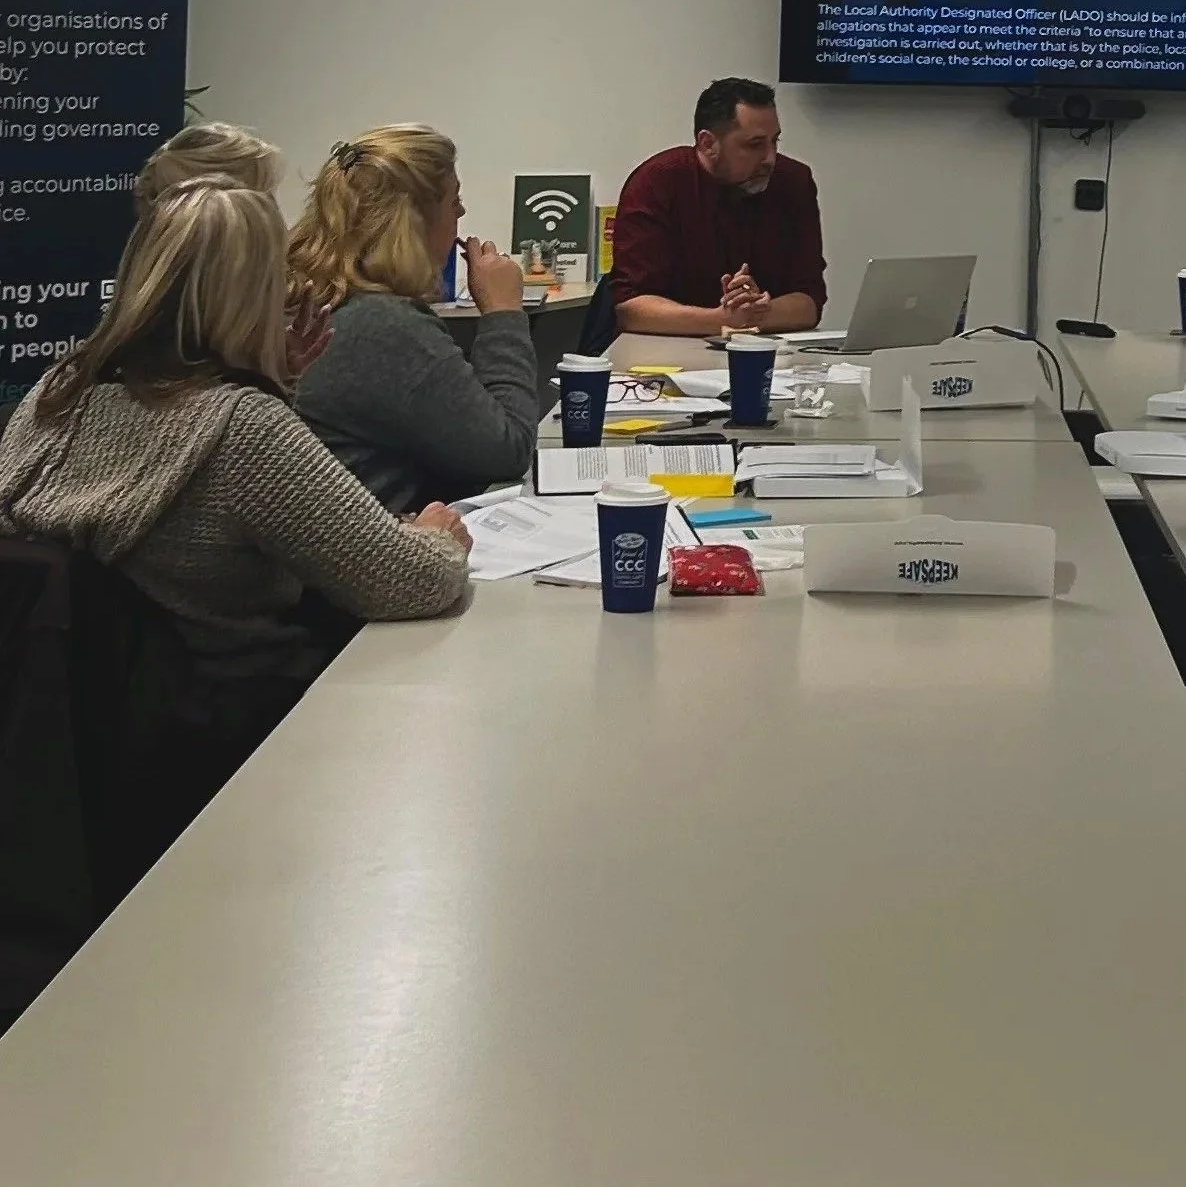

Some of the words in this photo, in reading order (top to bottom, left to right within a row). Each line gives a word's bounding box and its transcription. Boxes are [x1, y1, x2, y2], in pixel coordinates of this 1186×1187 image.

[7, 11, 144, 31] organisations
[148, 13, 168, 30] of
[817, 3, 842, 15] The
[844, 4, 877, 16] Local
[878, 5, 939, 19] Authority
[940, 6, 1013, 20] Designated
[1014, 8, 1057, 20] Officer
[1059, 9, 1104, 23] (LADO)
[1106, 10, 1149, 23] should
[1151, 11, 1168, 23] be
[816, 19, 886, 33] allegations
[887, 21, 915, 32] that
[916, 24, 962, 35] appear
[963, 23, 977, 34] to
[979, 24, 1013, 35] meet
[1015, 24, 1037, 36] the
[1038, 24, 1081, 37] criteria
[1103, 28, 1147, 38] ensure
[1148, 27, 1175, 39] that
[30, 40, 69, 59] you
[74, 40, 147, 58] protect
[816, 35, 898, 49] investigation
[900, 37, 911, 49] is
[912, 38, 956, 49] carried
[984, 39, 1039, 51] whether
[1040, 40, 1066, 52] that
[1068, 40, 1080, 52] is
[1080, 41, 1098, 55] by
[1098, 41, 1121, 53] the
[877, 53, 914, 64] social
[947, 53, 970, 66] the
[971, 54, 1013, 66] school
[1014, 57, 1029, 67] or
[1079, 59, 1094, 68] or
[1095, 59, 1104, 69] a
[1105, 58, 1185, 70] combination
[0, 92, 50, 114] ning
[54, 96, 100, 114] your
[0, 120, 37, 142] ing
[42, 122, 161, 142] governance
[0, 206, 31, 222] ce.
[37, 281, 89, 303] your
[14, 312, 38, 328] to
[615, 559, 646, 572] CCC
[898, 558, 959, 584] KEEPSAFE
